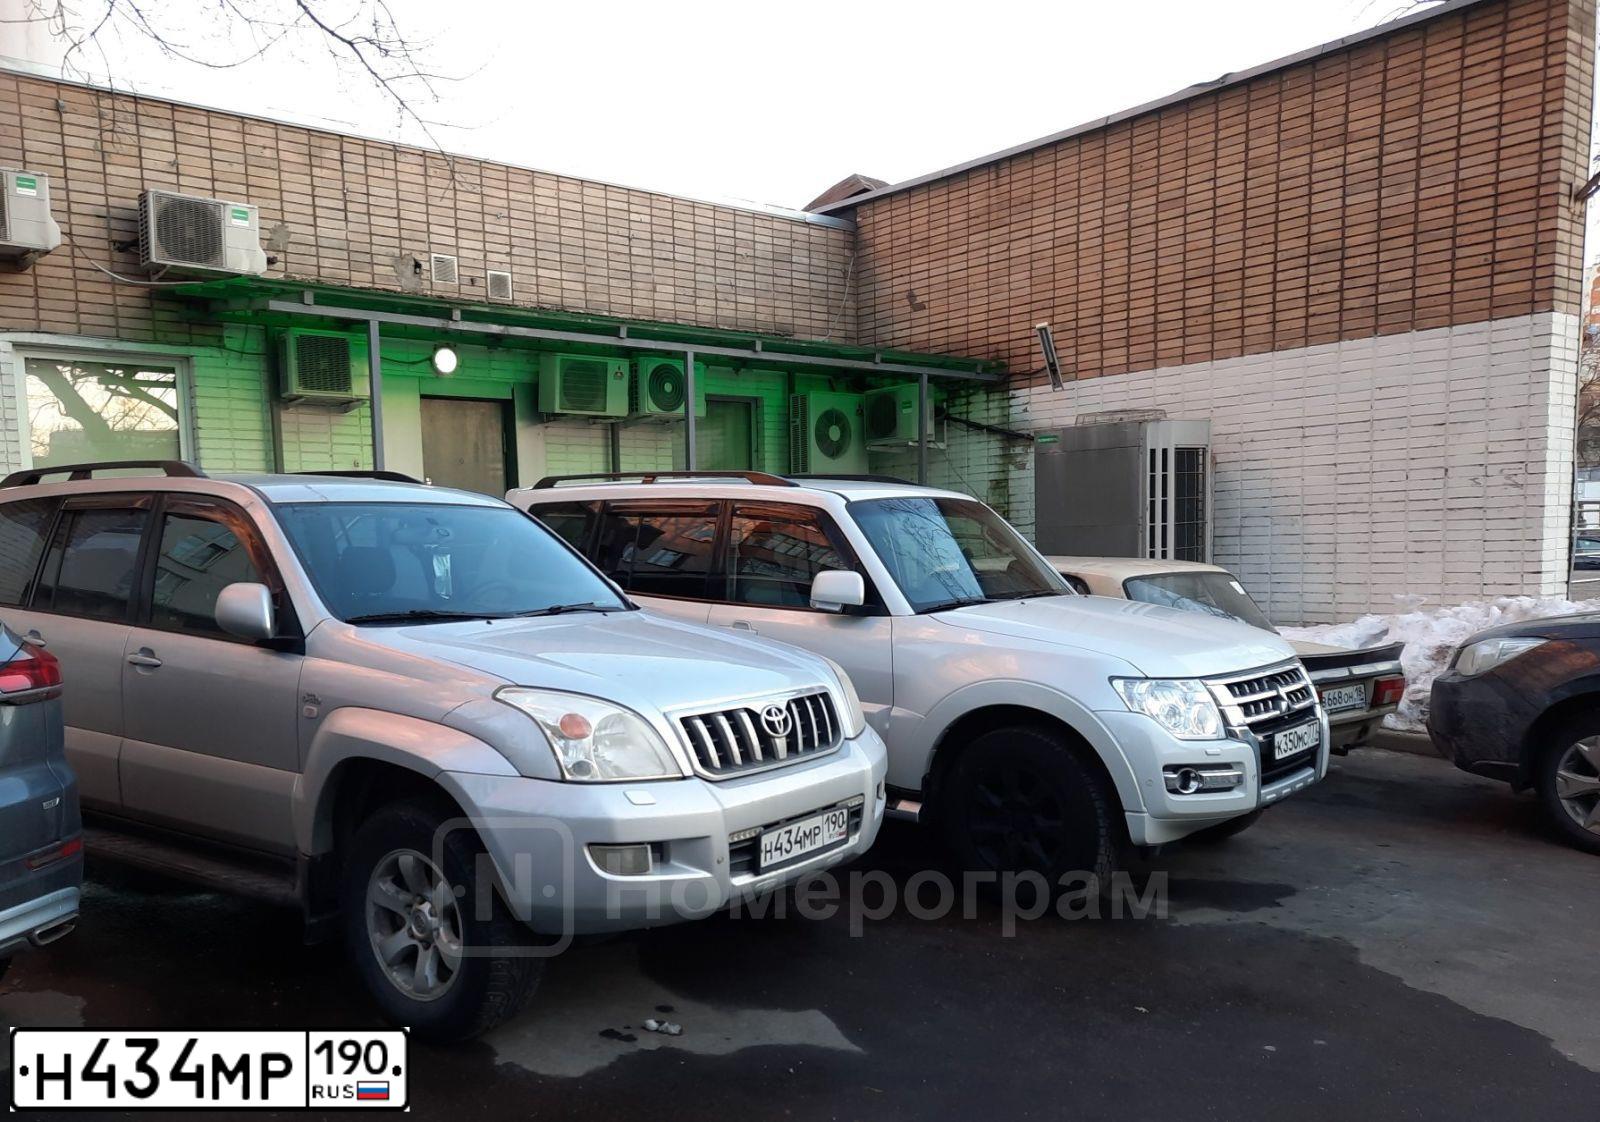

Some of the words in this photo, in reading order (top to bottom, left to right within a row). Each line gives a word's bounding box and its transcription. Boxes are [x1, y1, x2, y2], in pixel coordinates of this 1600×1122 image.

[1277, 731, 1307, 756] К350МС
[764, 825, 821, 863] Н434МР
[825, 811, 845, 833] 190
